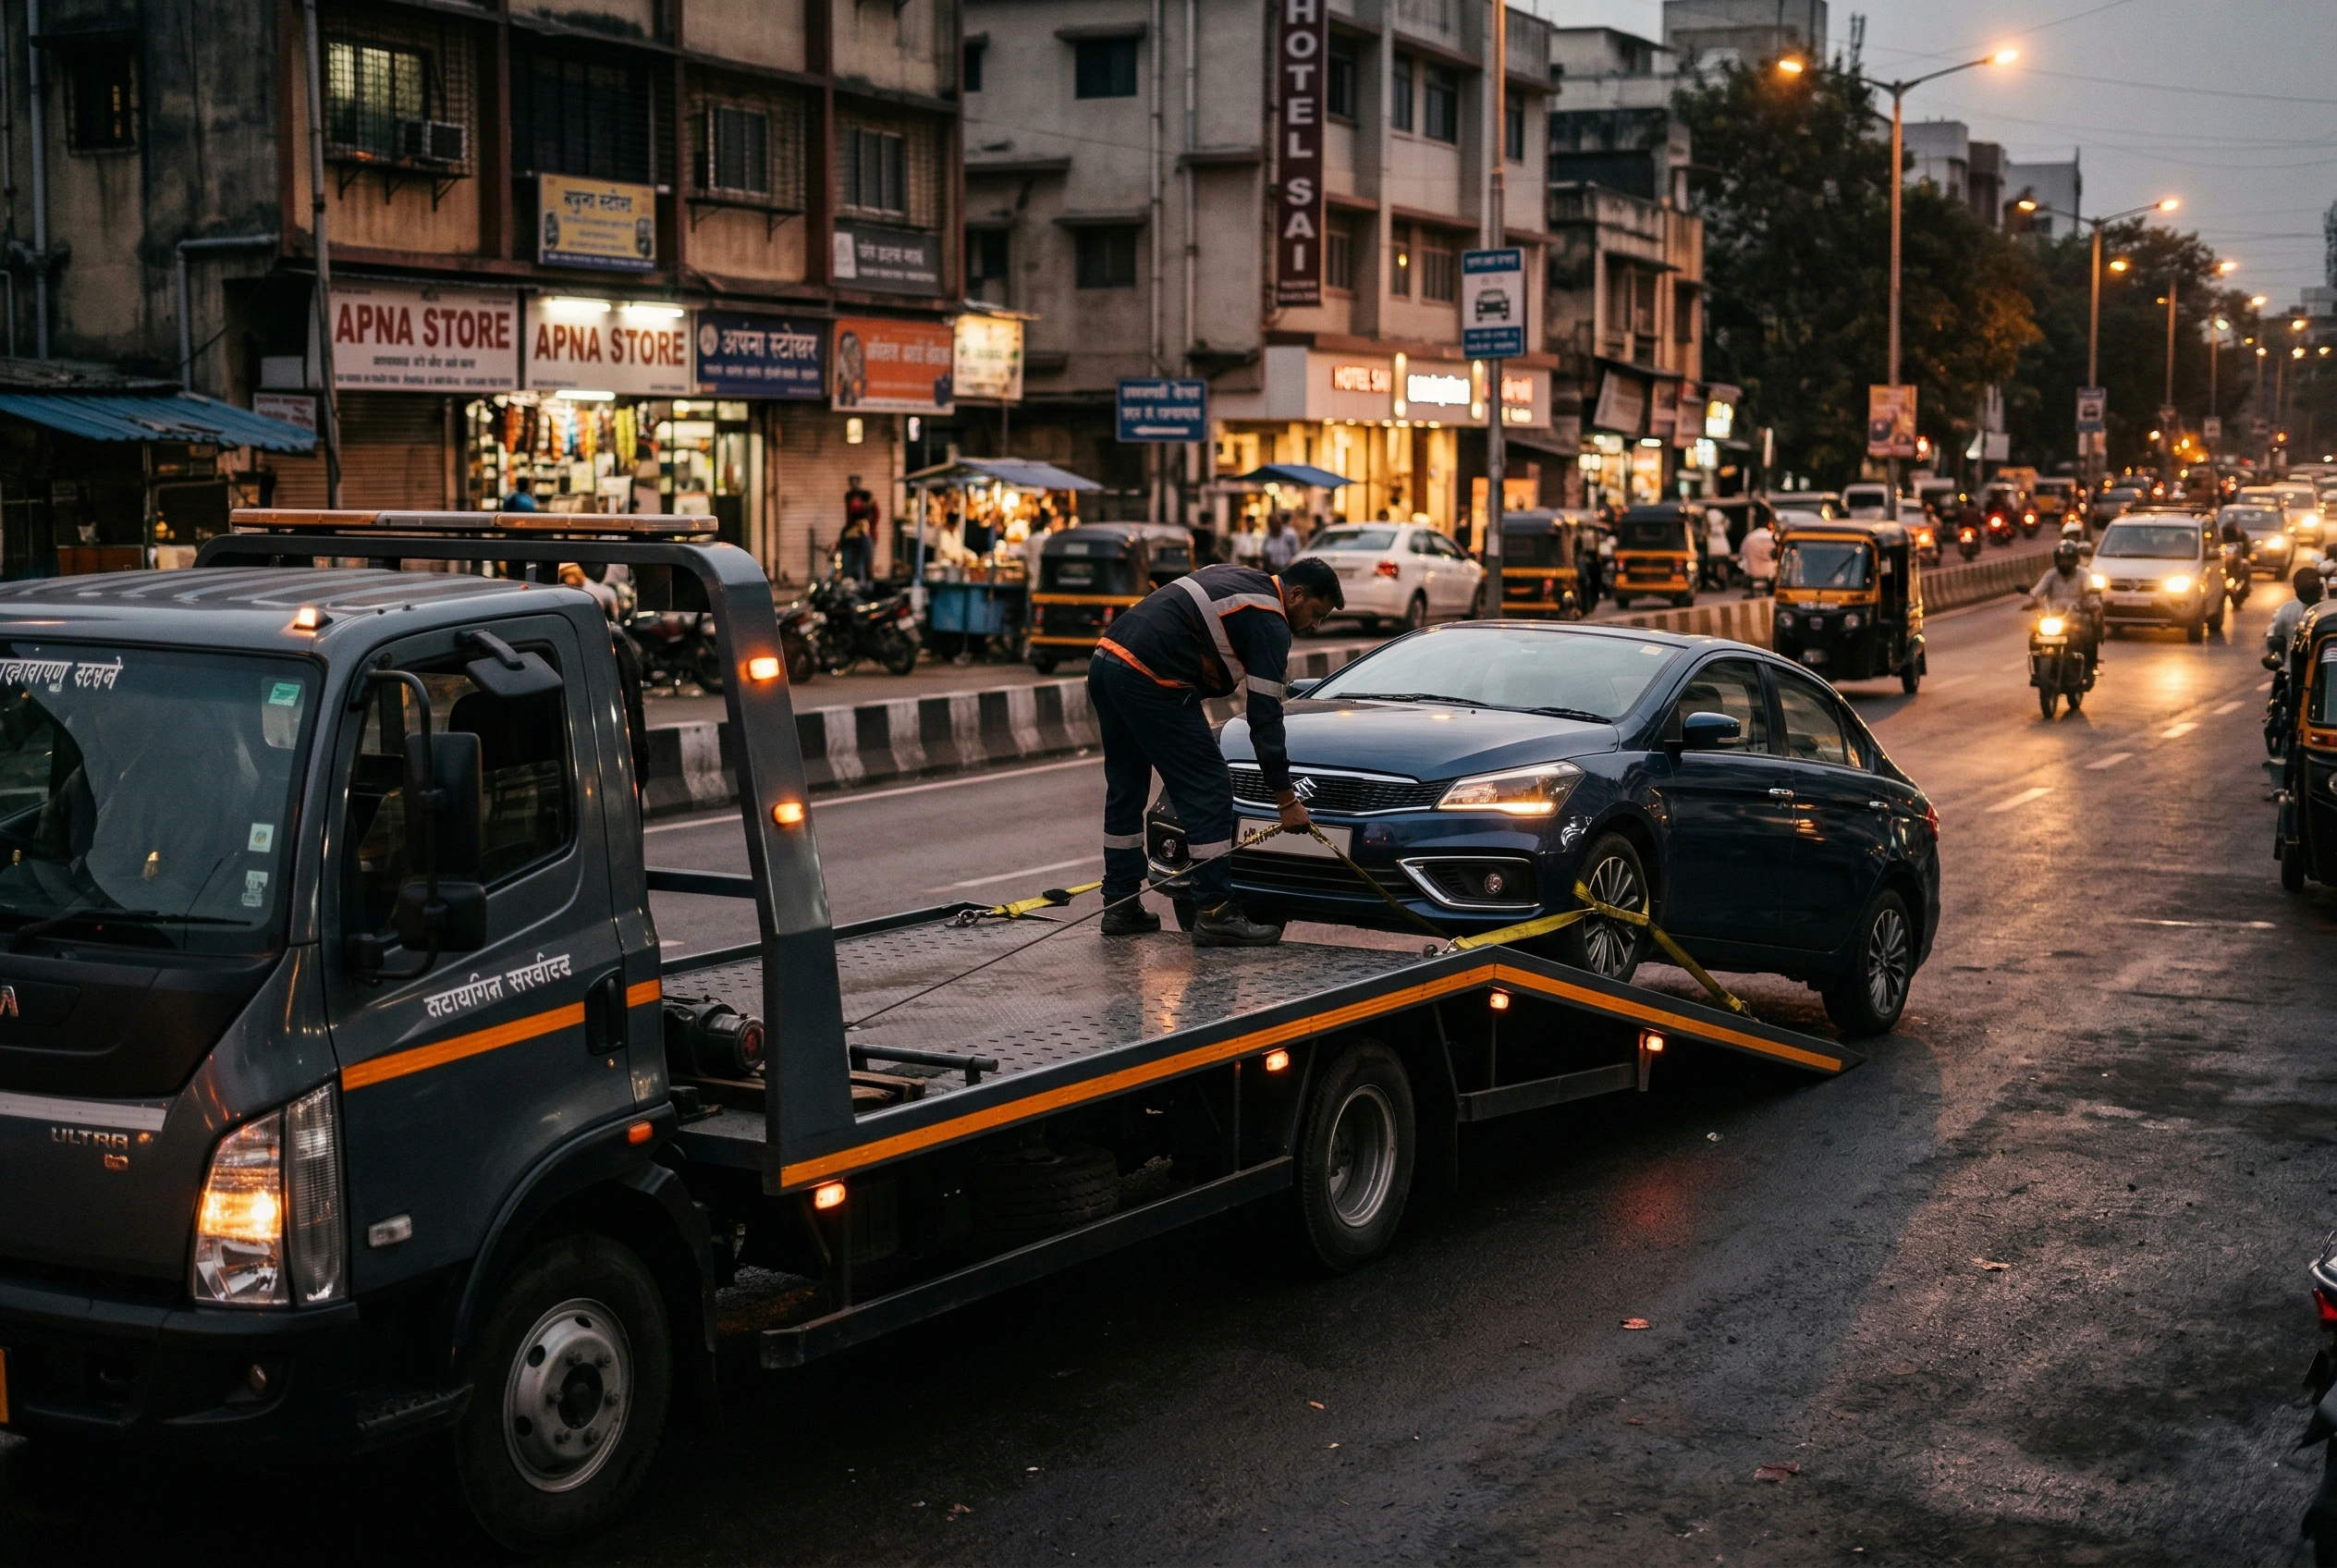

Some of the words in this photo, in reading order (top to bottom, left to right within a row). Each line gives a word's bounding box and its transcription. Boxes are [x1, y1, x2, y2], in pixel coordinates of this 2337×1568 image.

[1286, 0, 1318, 158] HOTEL
[1283, 177, 1316, 272] SAI
[336, 302, 414, 346] APNA
[422, 307, 511, 349] STORE
[534, 324, 603, 362] APNA
[610, 326, 686, 365] STORE
[51, 1126, 128, 1150] ULTRA
